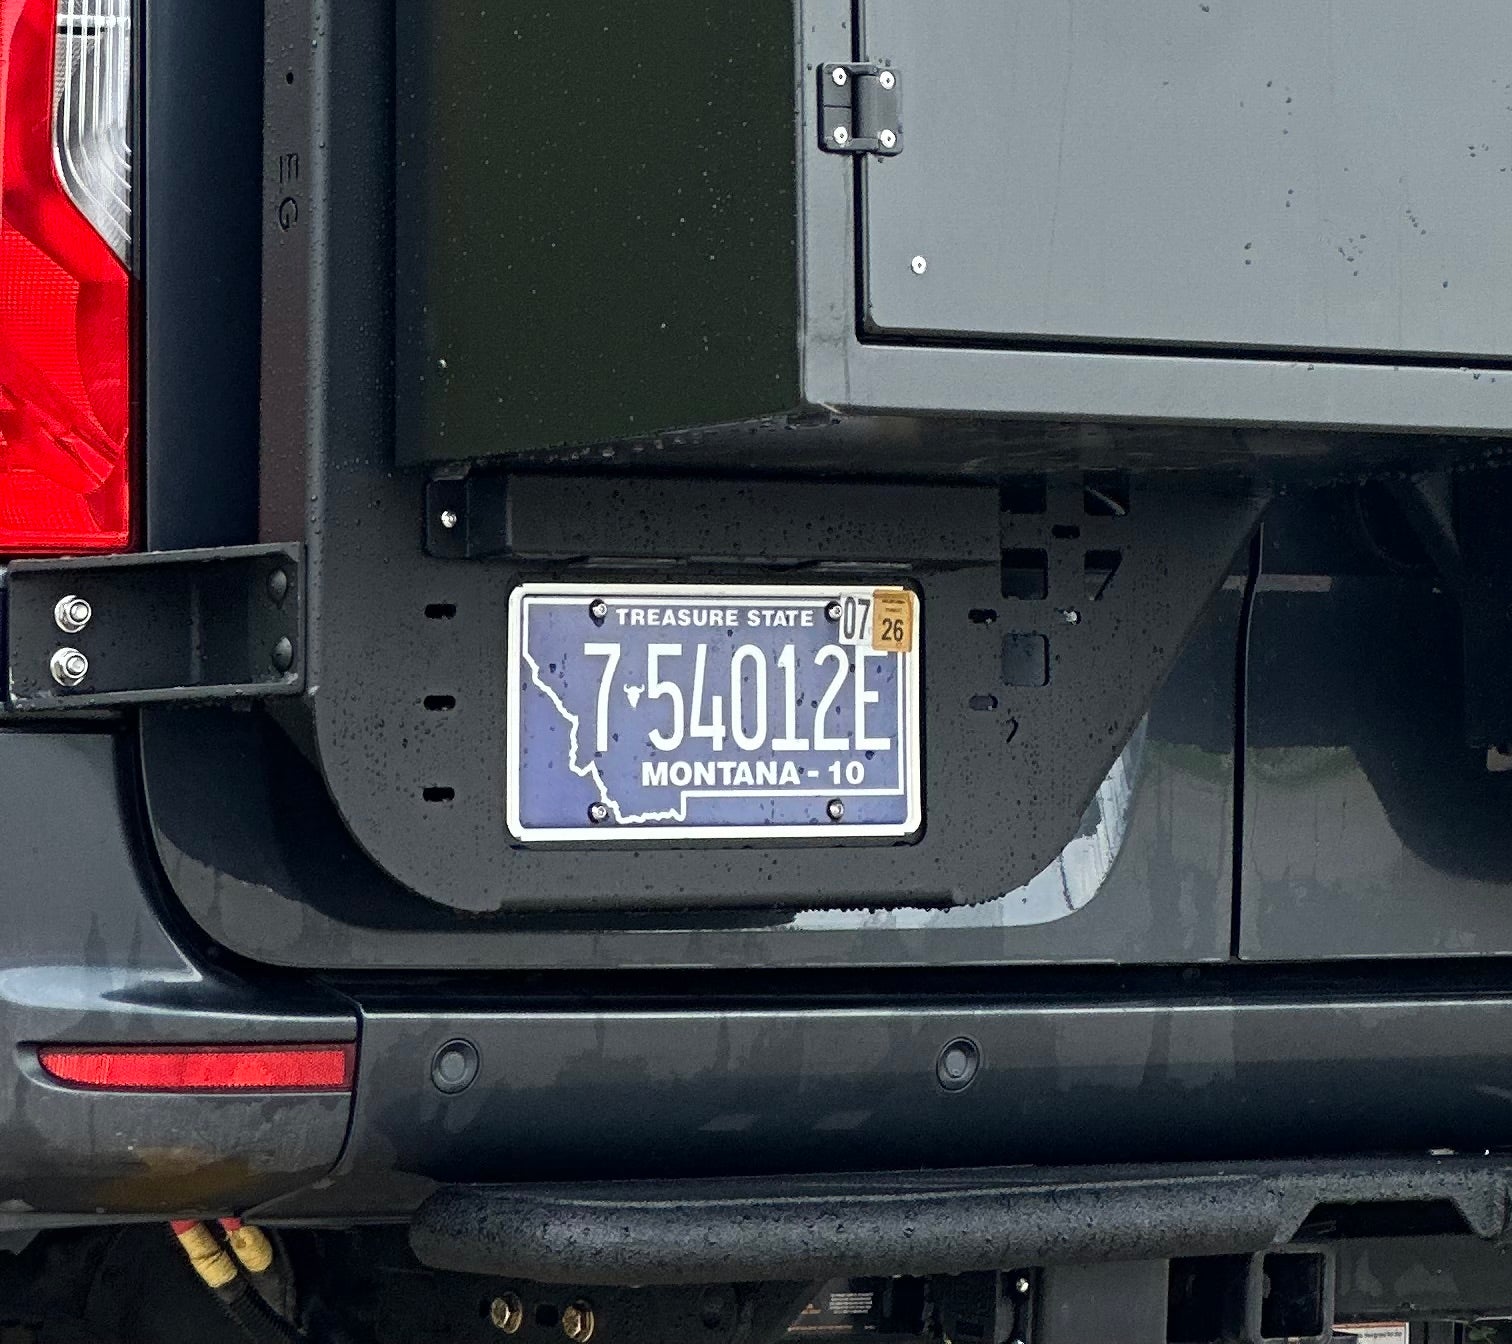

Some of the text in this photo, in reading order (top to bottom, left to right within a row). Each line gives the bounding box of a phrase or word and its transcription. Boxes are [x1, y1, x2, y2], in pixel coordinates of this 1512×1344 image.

[616, 608, 814, 627] TREASURE STATE
[844, 596, 871, 640] 07
[881, 617, 904, 642] 26
[642, 761, 800, 787] MONTANA
[828, 761, 865, 786] 10
